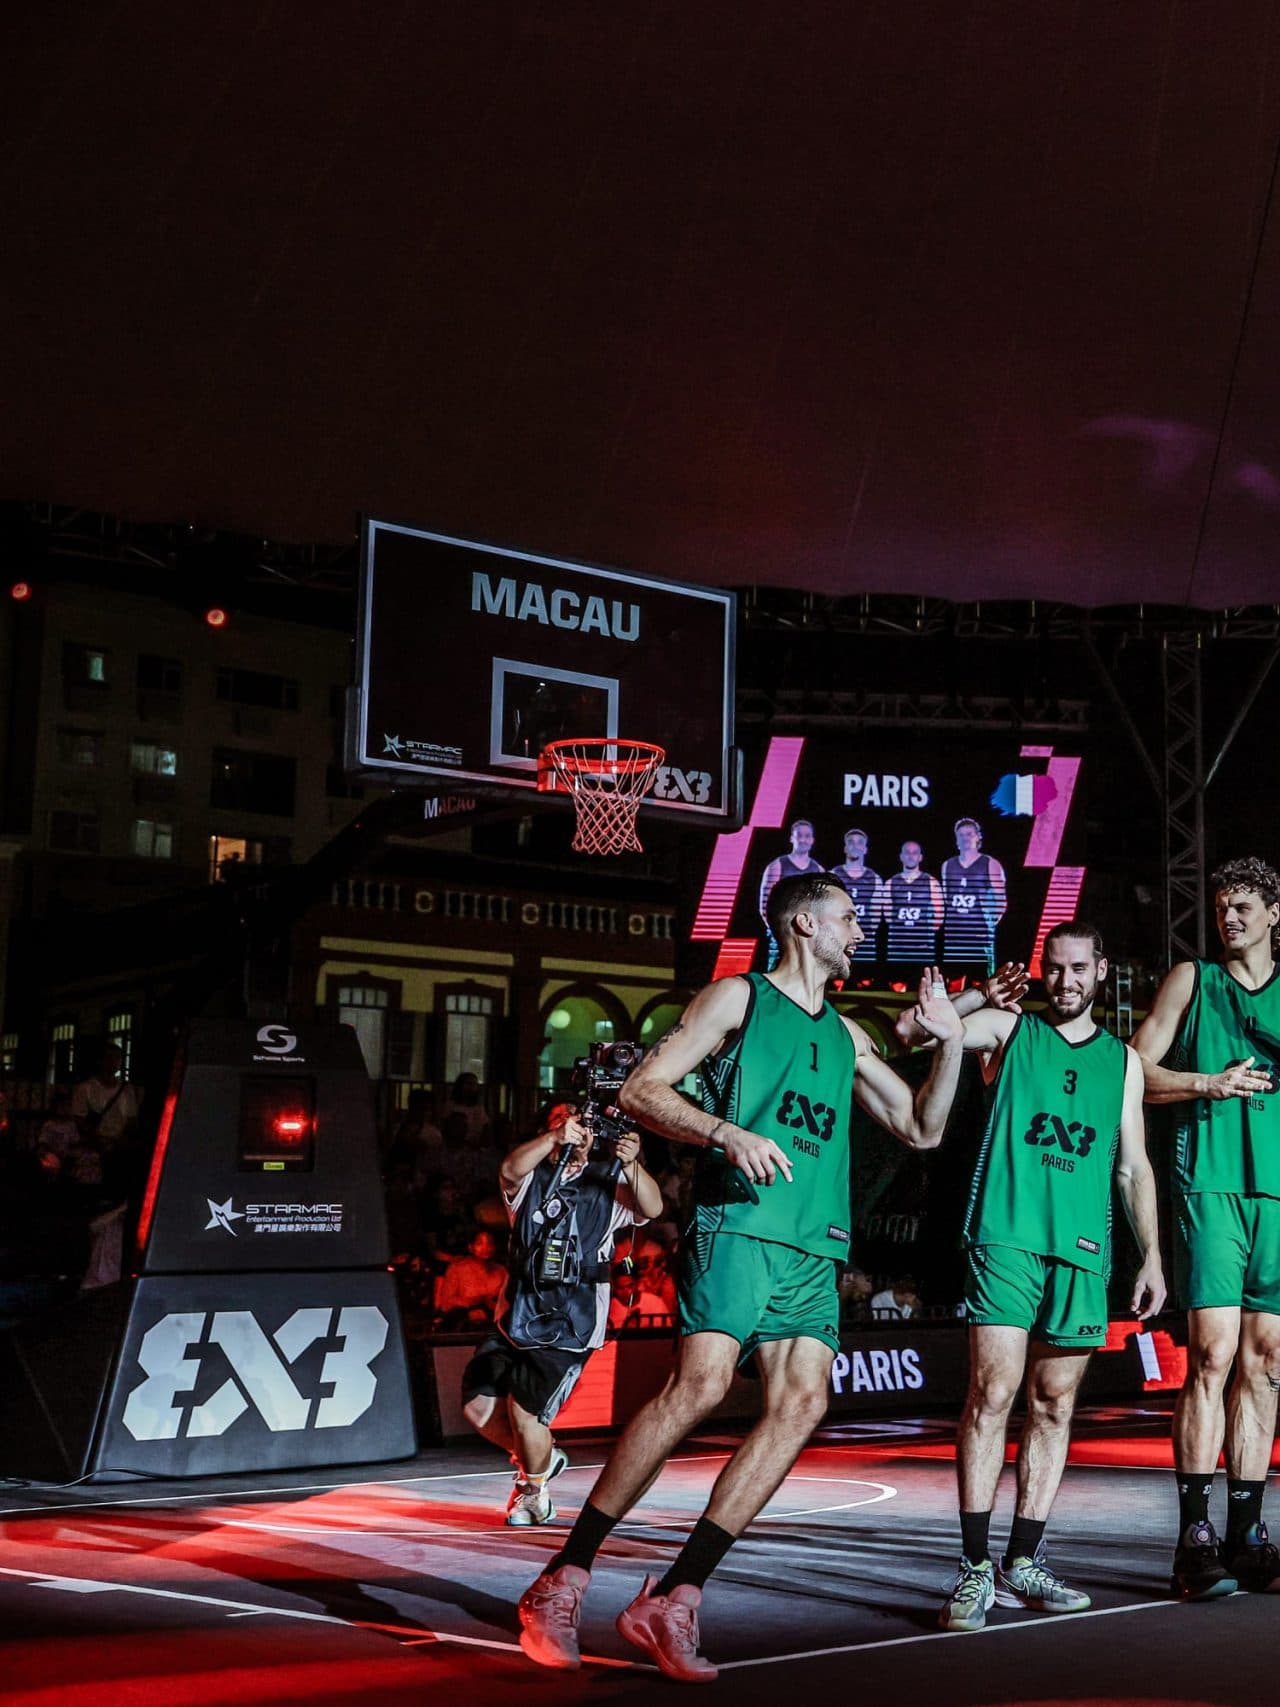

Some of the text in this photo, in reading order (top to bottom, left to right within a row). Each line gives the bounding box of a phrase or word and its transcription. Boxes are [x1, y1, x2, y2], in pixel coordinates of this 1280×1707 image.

[471, 571, 641, 642] MACAU
[842, 773, 931, 809] PARIS
[809, 1042, 819, 1072] 1
[1063, 1069, 1078, 1095] 3
[792, 1135, 820, 1158] PARIS
[1041, 1153, 1075, 1173] PARIS
[246, 1203, 343, 1214] STARMAC
[831, 1347, 926, 1395] PARIS
